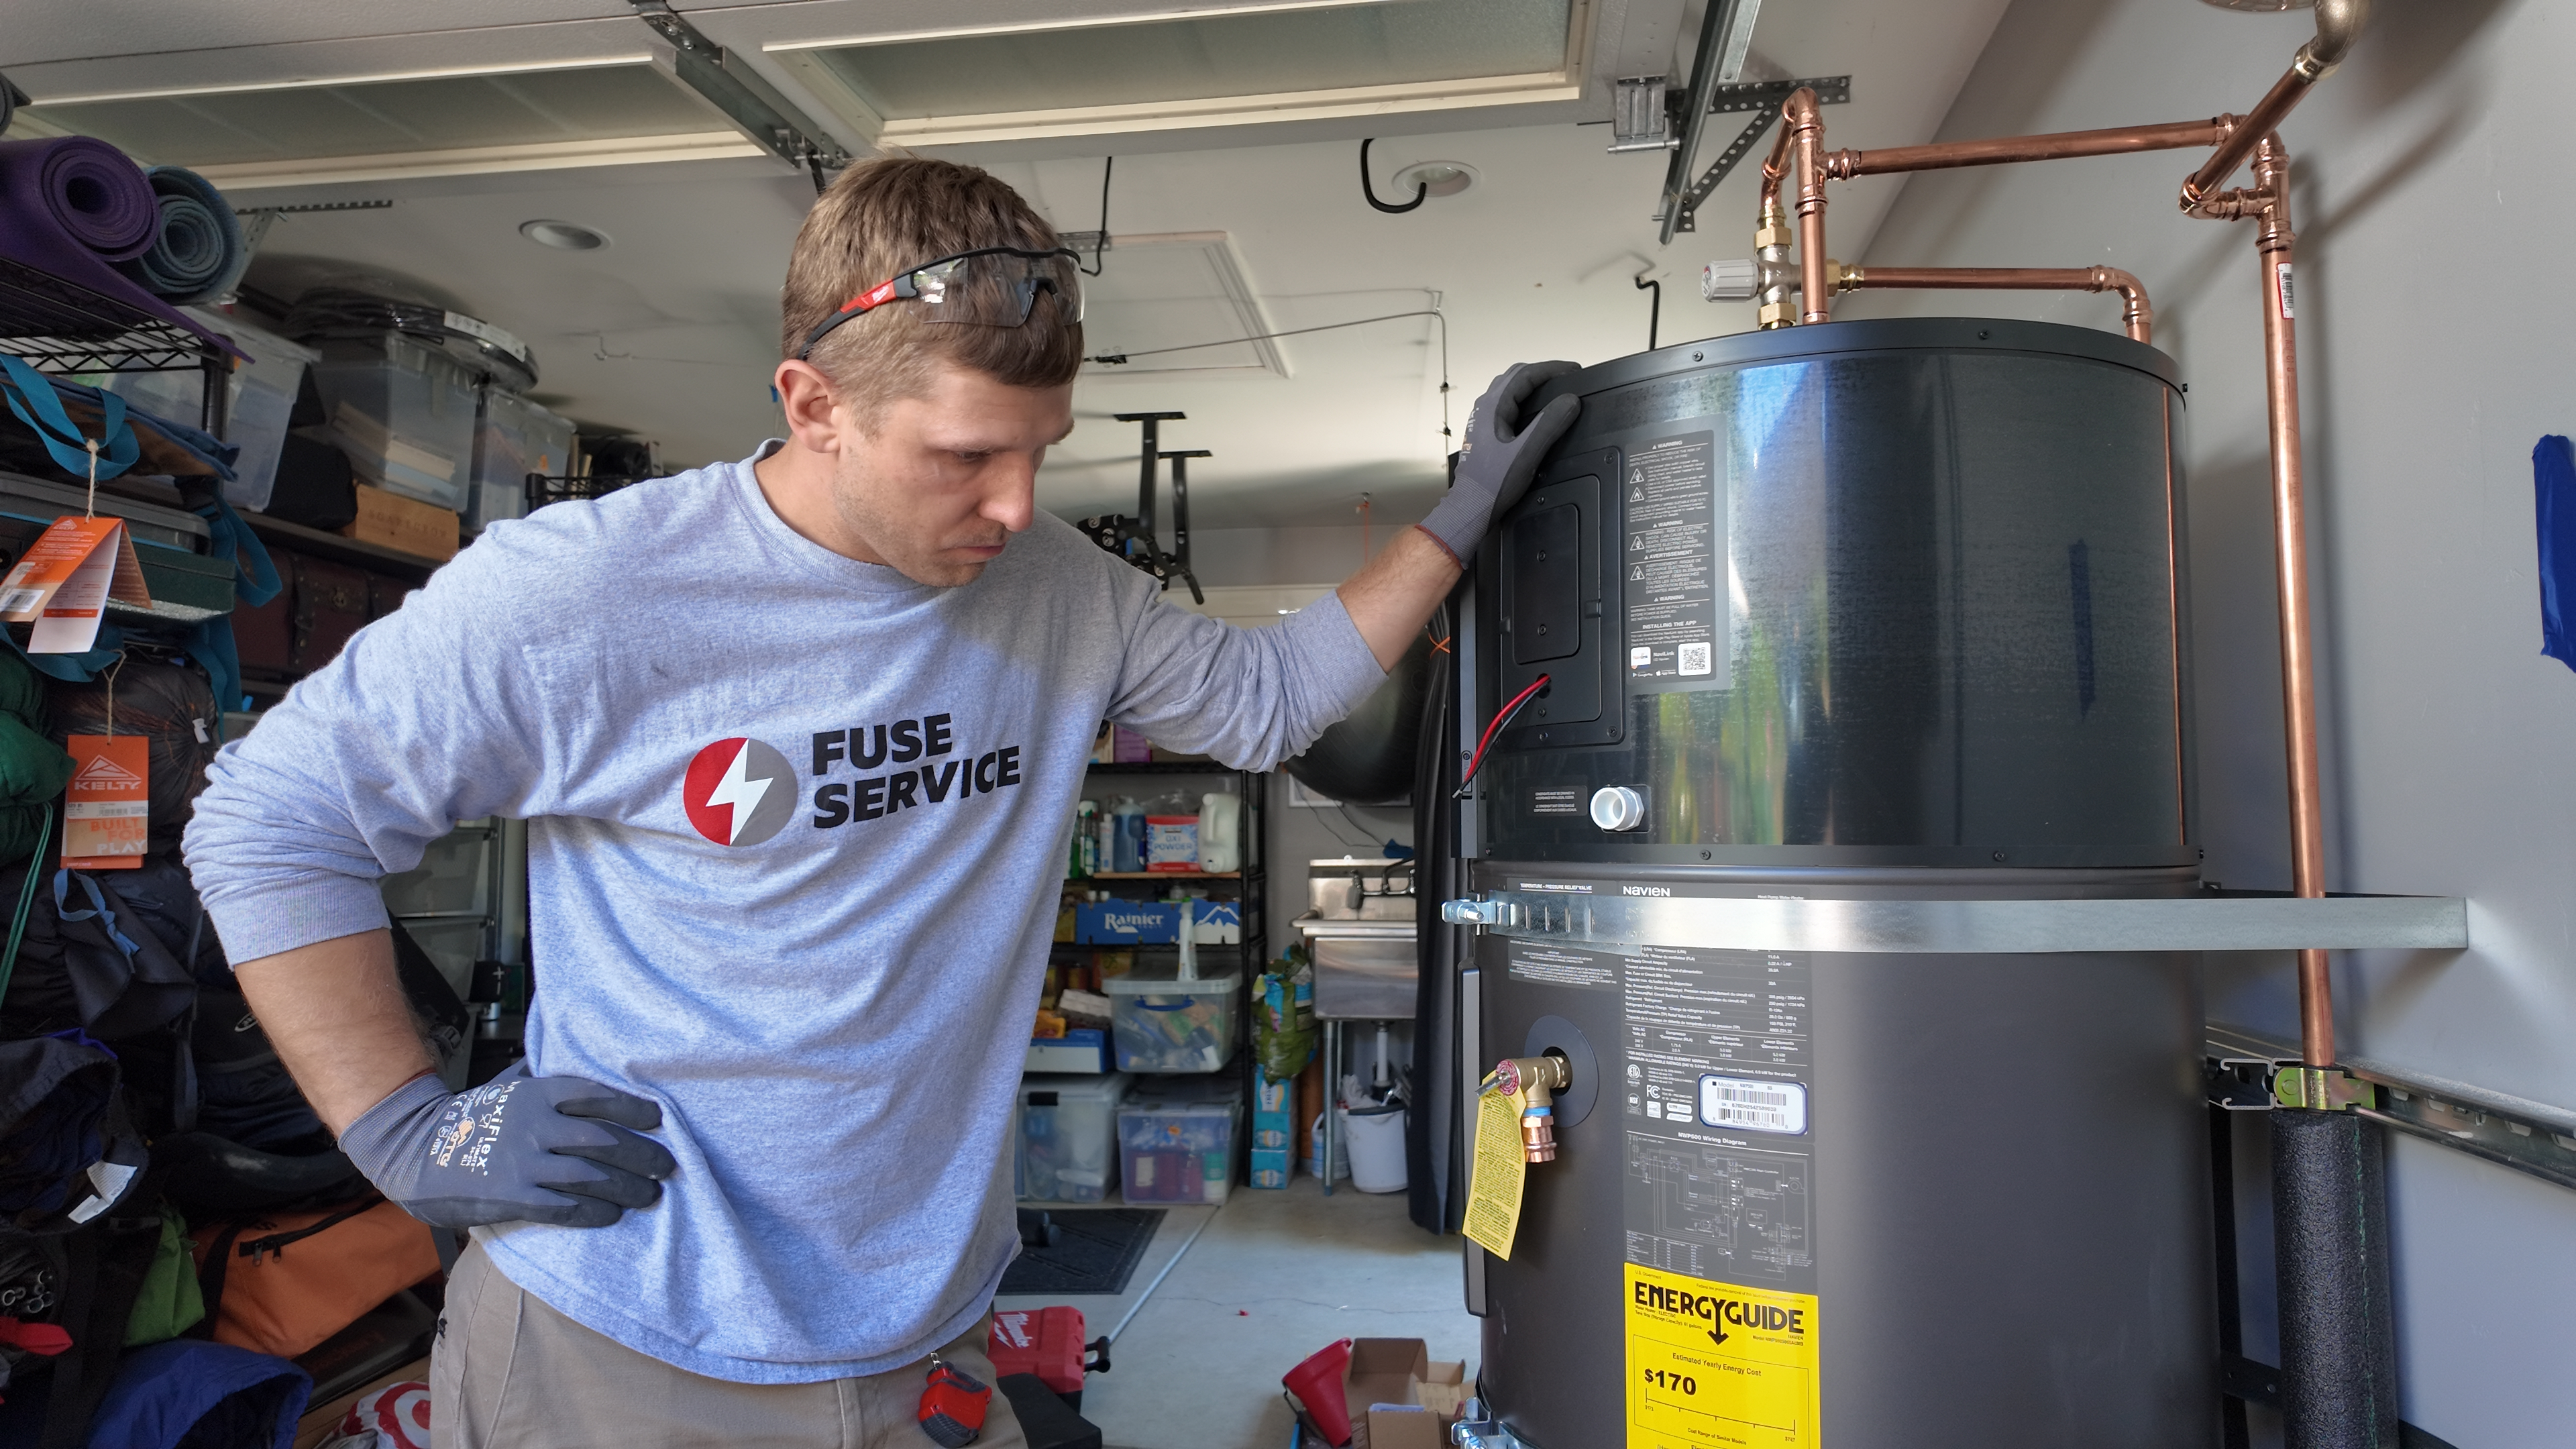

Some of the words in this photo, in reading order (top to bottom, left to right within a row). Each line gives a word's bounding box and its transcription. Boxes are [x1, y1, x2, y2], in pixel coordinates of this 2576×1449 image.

[1658, 440, 1682, 448] WARNING
[812, 713, 953, 775] FUSE
[74, 781, 142, 790] KELTY
[813, 746, 1020, 828] SERVICE
[91, 817, 140, 832] BUILT
[107, 828, 146, 841] FOR
[97, 840, 146, 855] PLAY
[1104, 914, 1164, 930] Rainier
[1703, 1136, 1721, 1144] Wiring
[1723, 1138, 1747, 1146] Diagram
[1635, 1281, 1804, 1336] ENERGYGUIDE
[1672, 1352, 1701, 1366] Estimated
[1703, 1359, 1721, 1371] Yearly
[1723, 1363, 1745, 1375] Energy
[1644, 1368, 1697, 1396] $170
[1698, 1430, 1711, 1438] Range
